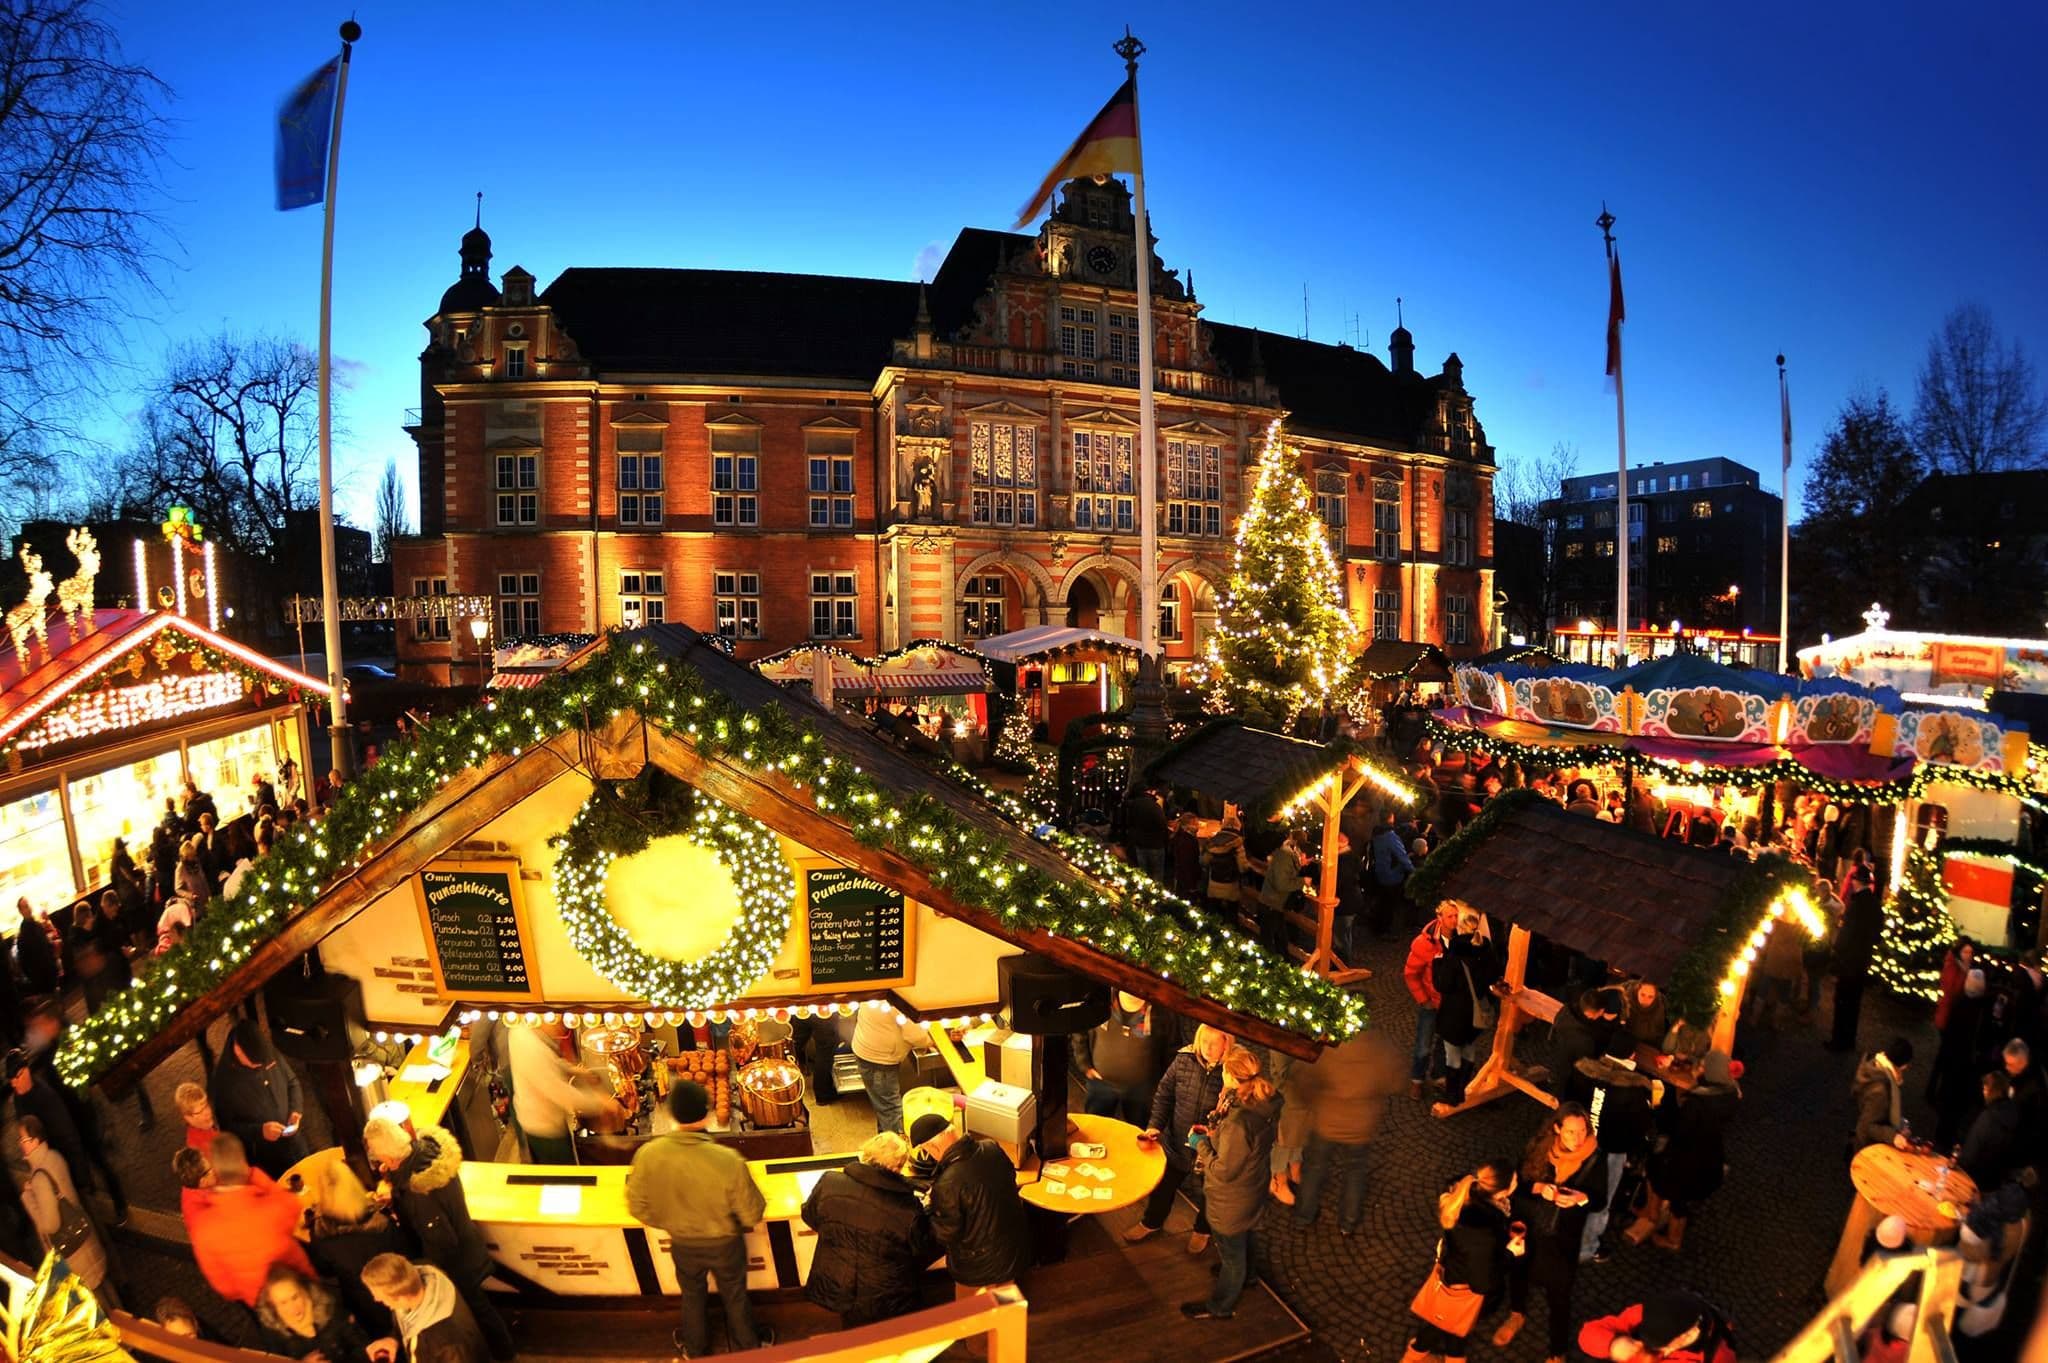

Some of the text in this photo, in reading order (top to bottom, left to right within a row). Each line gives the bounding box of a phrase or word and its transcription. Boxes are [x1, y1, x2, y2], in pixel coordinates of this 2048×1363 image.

[424, 872, 456, 882] Oma's
[811, 872, 846, 880] Oma's
[428, 881, 510, 906] Punschhütte
[431, 908, 460, 922] Punsch
[809, 907, 833, 922] Grog
[880, 907, 899, 915] 2,50
[433, 922, 460, 935] Punsch
[810, 920, 842, 930] Cranberry
[880, 918, 899, 926] 2,50
